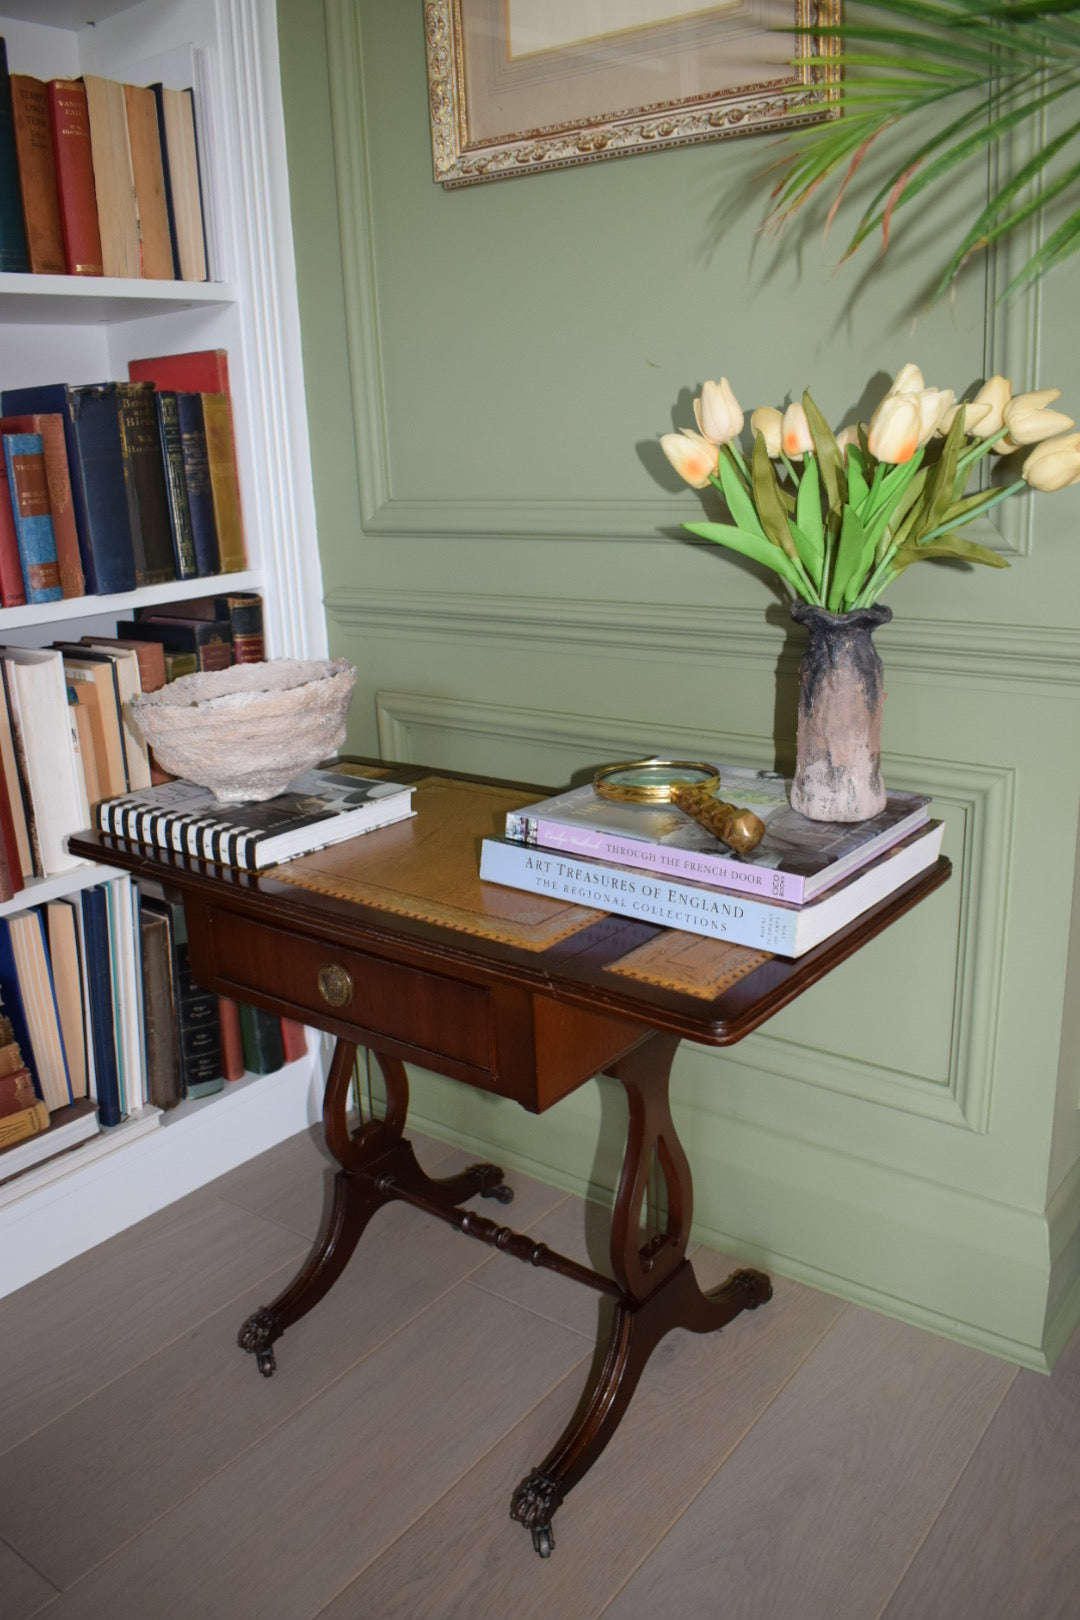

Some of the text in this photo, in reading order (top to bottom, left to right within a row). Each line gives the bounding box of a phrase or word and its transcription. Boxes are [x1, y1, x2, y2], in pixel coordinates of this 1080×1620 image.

[525, 856, 744, 920] ART TREASURES OF ENGLAND
[606, 843, 763, 886] THROUGH THE FRENCH DOOR
[536, 877, 728, 933] THE REGIONAL COLLECTIONS
